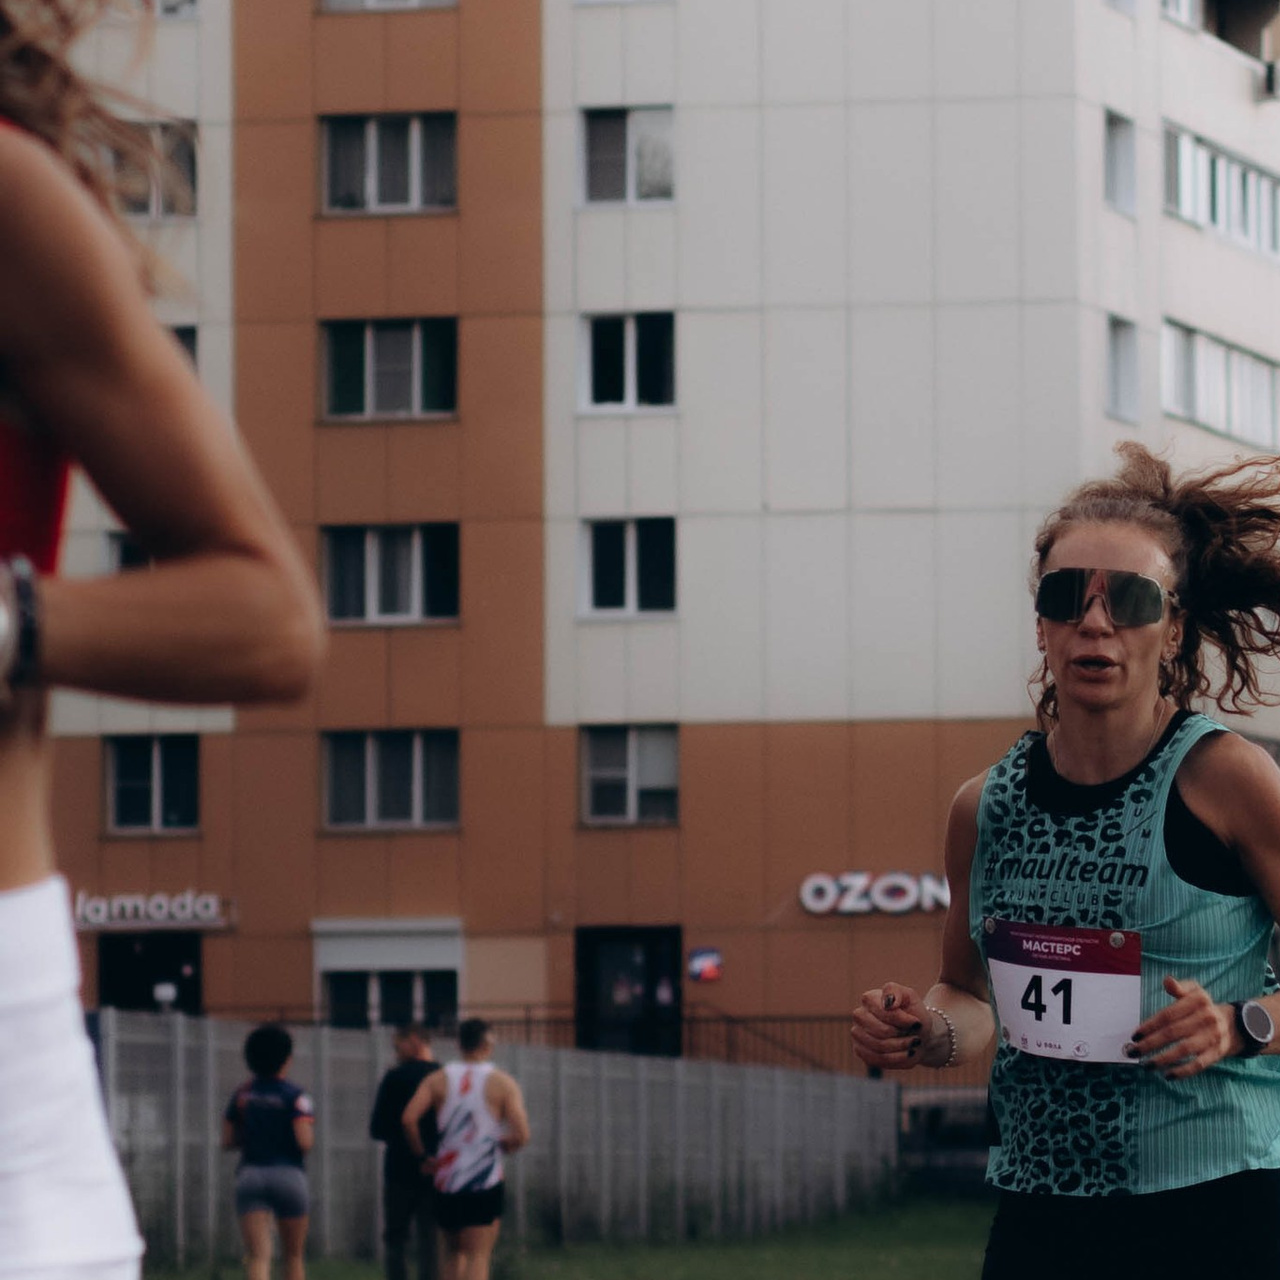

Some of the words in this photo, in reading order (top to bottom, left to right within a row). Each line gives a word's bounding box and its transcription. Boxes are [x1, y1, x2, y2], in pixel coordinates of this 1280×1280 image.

[984, 851, 1149, 887] #maulteam
[75, 889, 218, 924] lamoda
[801, 872, 951, 913] OZON
[1007, 889, 1036, 902] RUN
[1050, 890, 1099, 905] CLUB
[1022, 939, 1082, 956] МАСТЕРС
[1021, 974, 1072, 1025] 41
